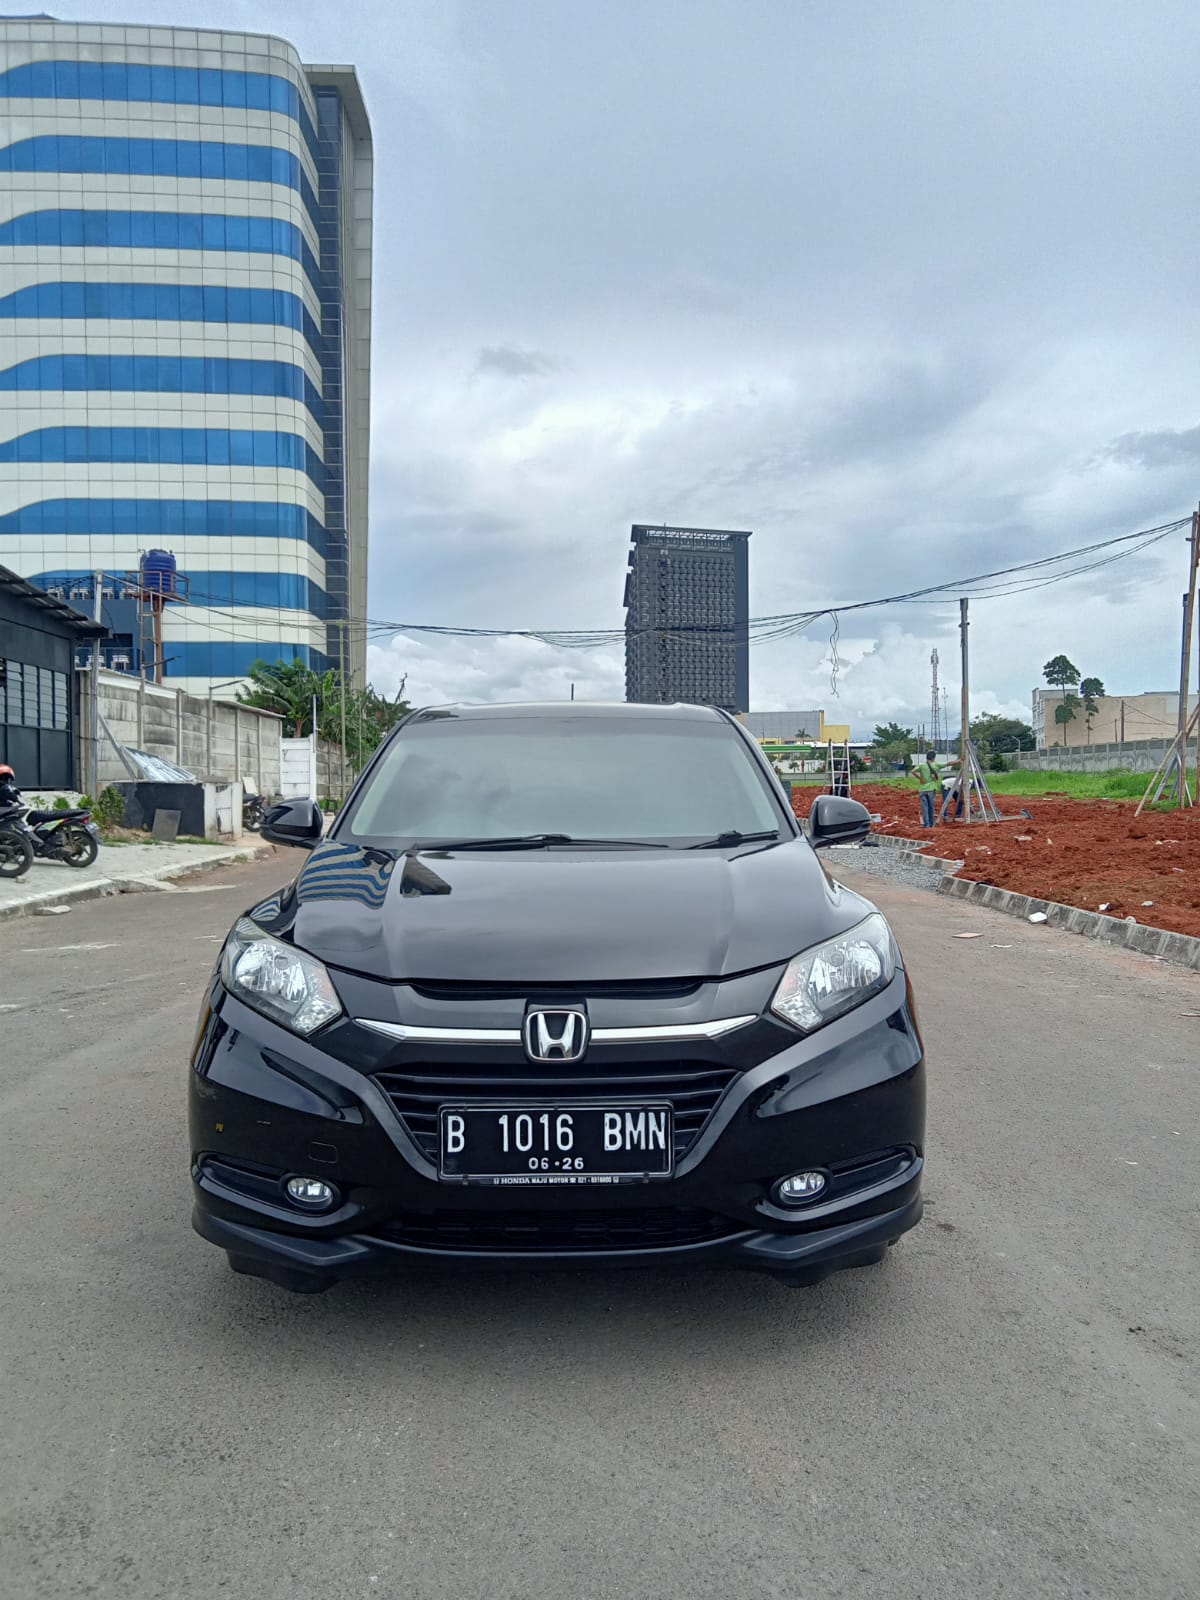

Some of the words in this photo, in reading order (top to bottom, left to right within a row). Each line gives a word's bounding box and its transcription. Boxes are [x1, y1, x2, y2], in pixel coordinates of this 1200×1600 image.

[447, 1115, 465, 1152] B
[498, 1113, 574, 1152] 1016
[603, 1112, 666, 1151] BMN
